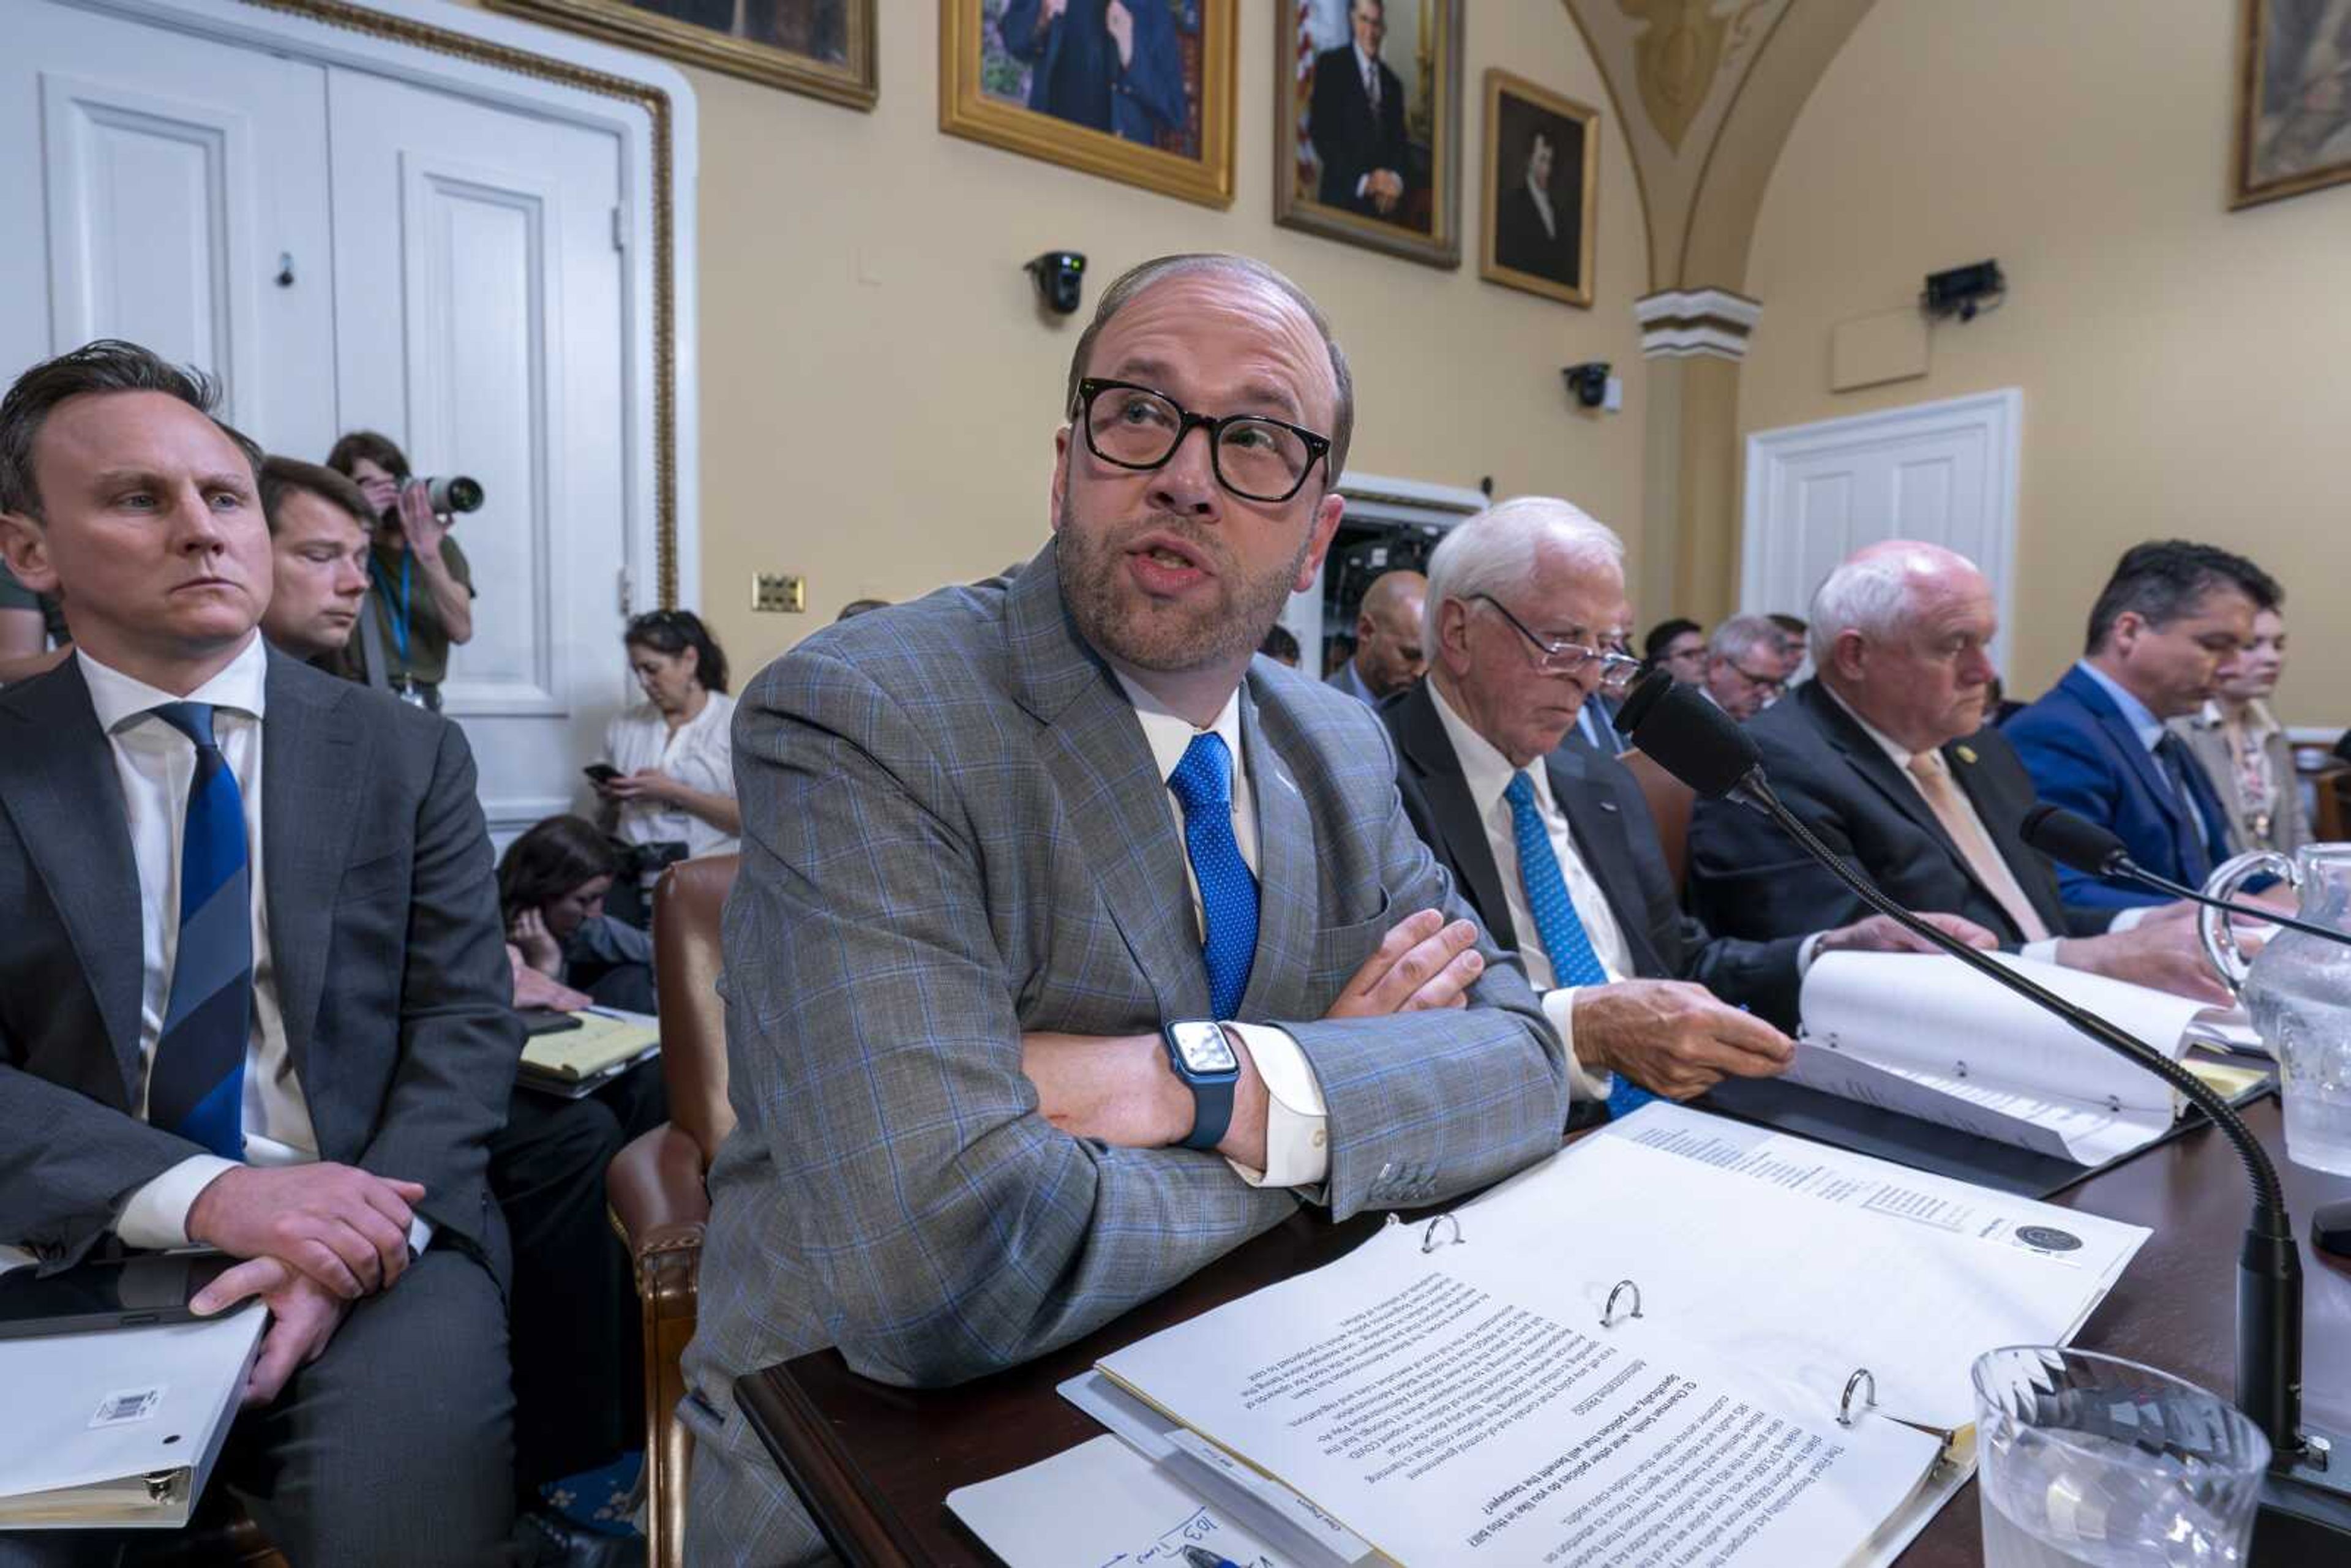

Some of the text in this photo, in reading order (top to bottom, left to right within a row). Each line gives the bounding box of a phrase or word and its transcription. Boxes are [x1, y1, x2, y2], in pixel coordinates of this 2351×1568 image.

[1651, 1389, 1689, 1417] Chairman
[1627, 1415, 1658, 1433] Smith,
[1481, 1373, 1681, 1516] Specifically, any policies that will benefit the taxpayer?
[1609, 1433, 1632, 1449] what
[1589, 1446, 1613, 1465] other
[1558, 1460, 1592, 1484] policies
[1529, 1488, 1550, 1503] you
[1514, 1500, 1537, 1514] like
[1486, 1518, 1510, 1532] this
[1466, 1529, 1493, 1548] bill?
